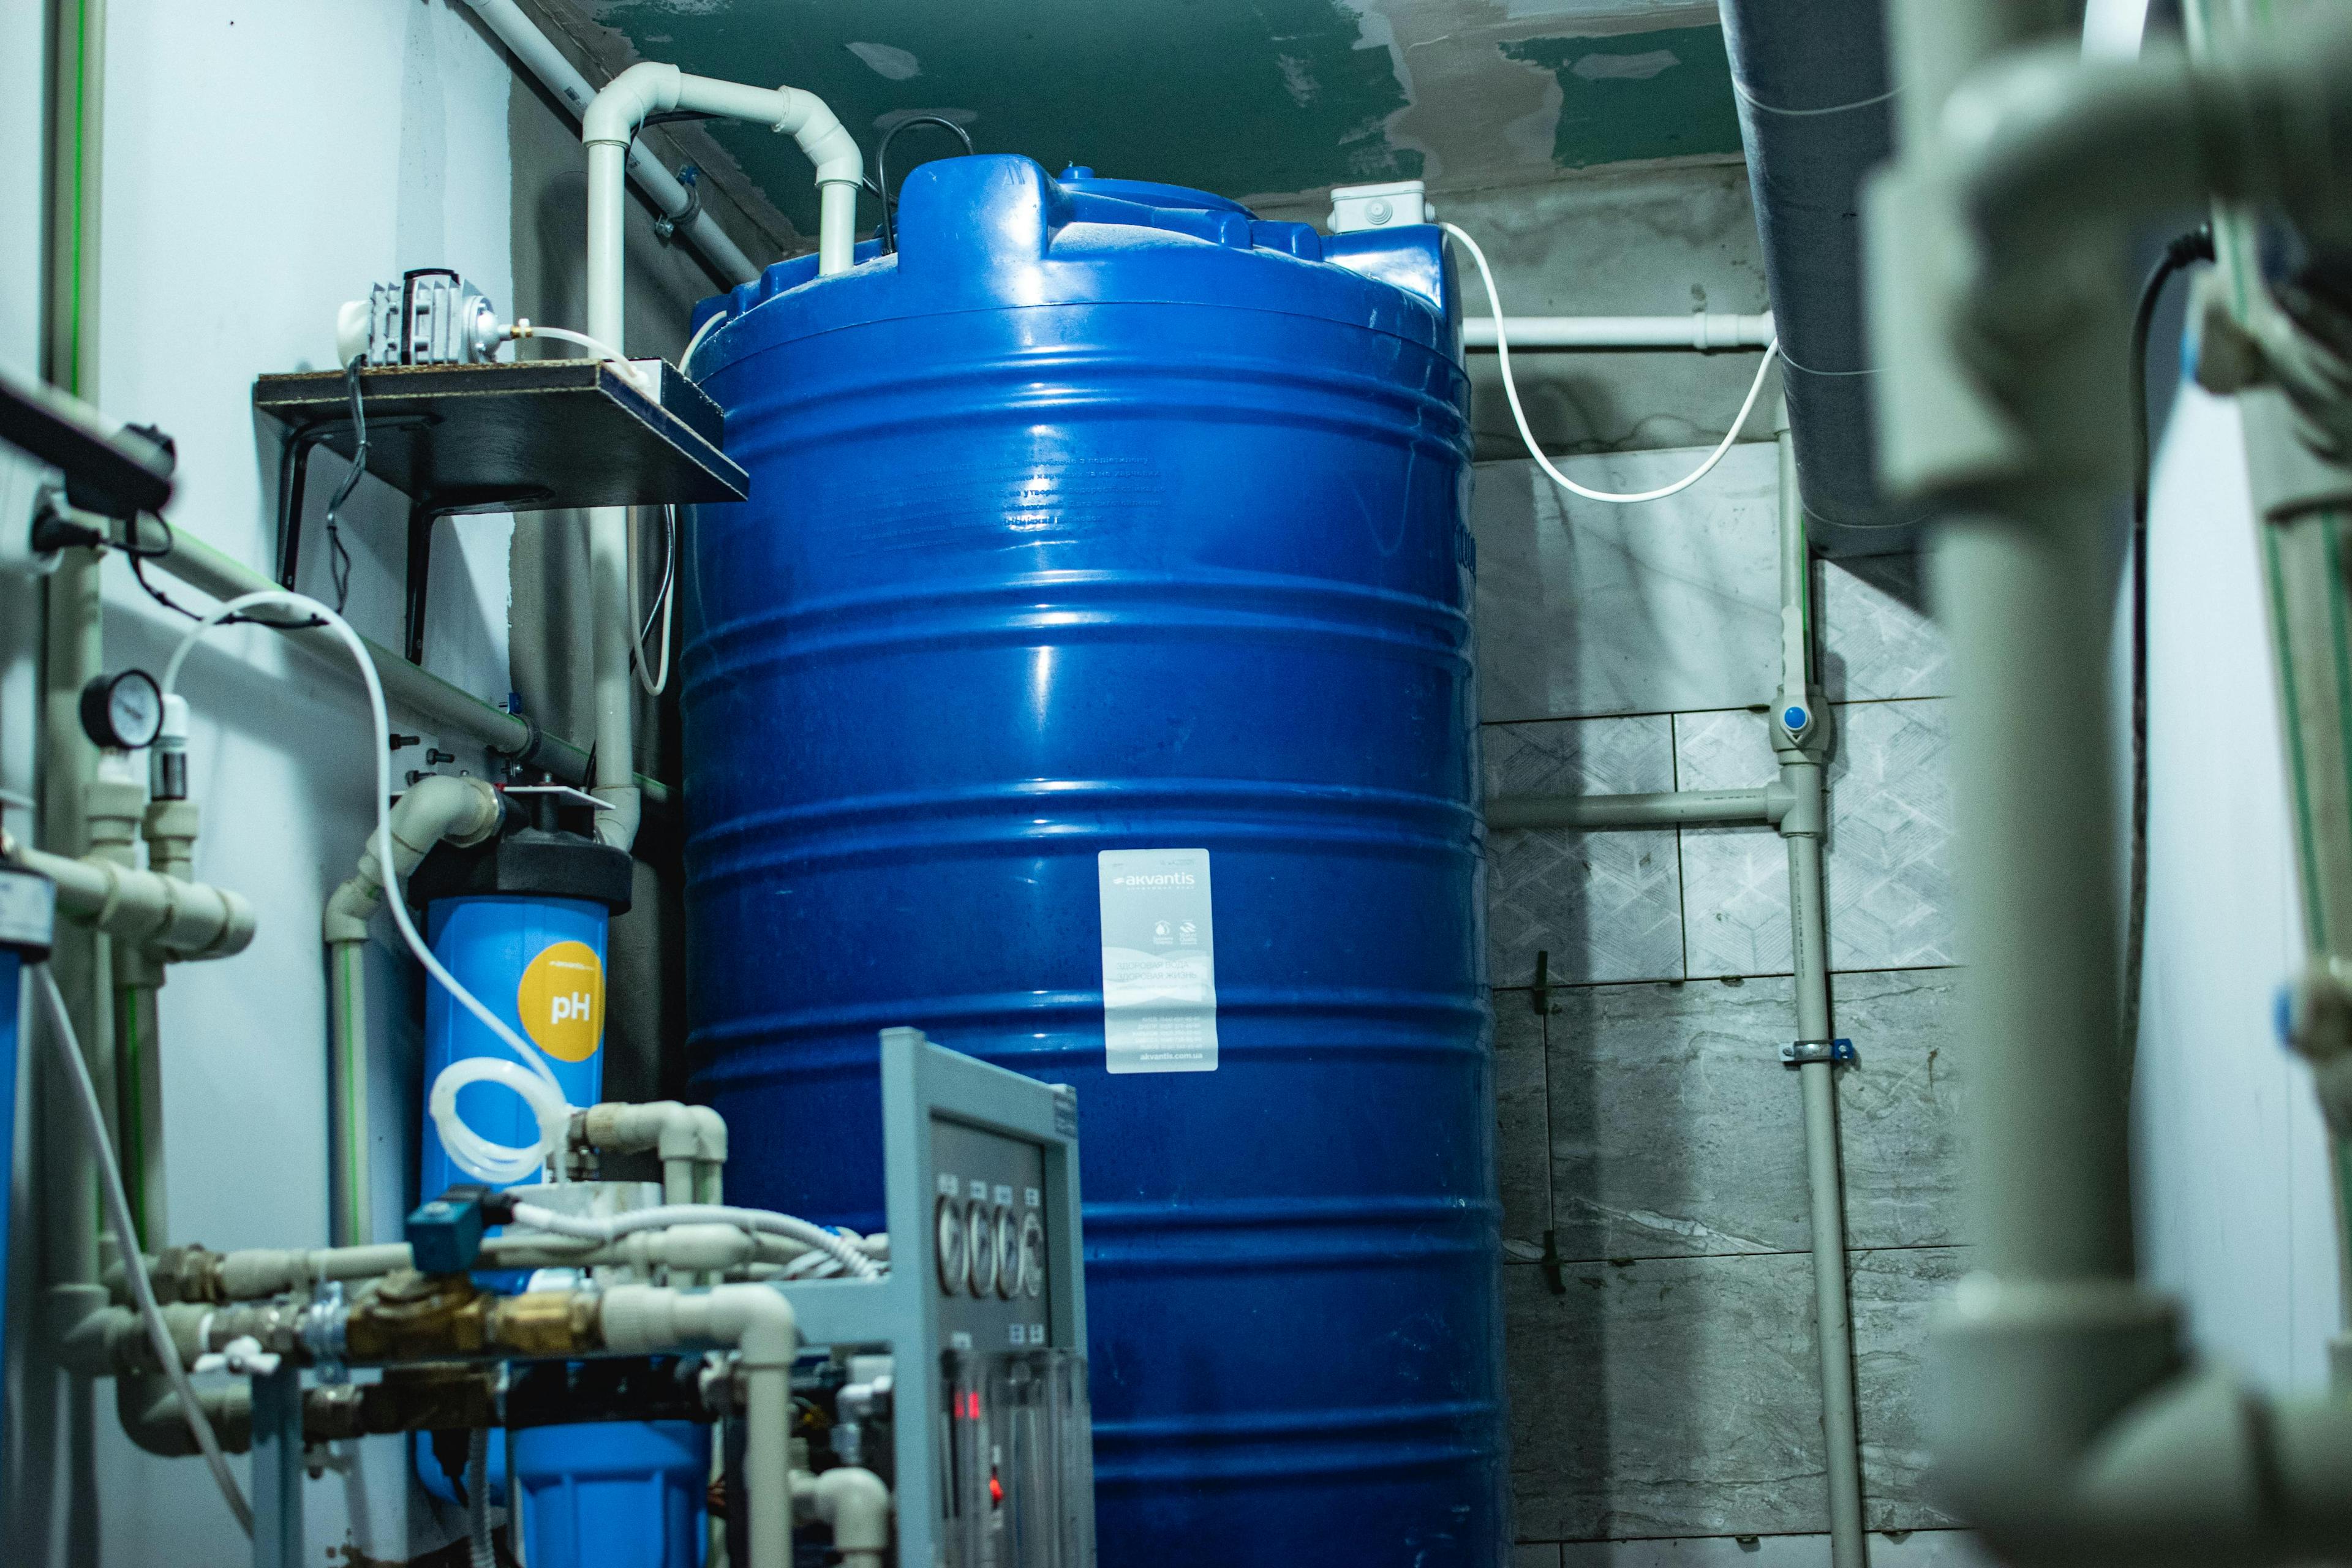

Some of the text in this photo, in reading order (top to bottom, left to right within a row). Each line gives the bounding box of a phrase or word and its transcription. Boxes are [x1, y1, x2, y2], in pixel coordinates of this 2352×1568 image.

[1125, 872, 1195, 886] akvantis
[1117, 960, 1189, 970] ЗДОРОВАЯ ВОДА
[1117, 971, 1197, 981] ЗДОРОВАЯ ЖИЗНЬ
[551, 992, 590, 1025] pH
